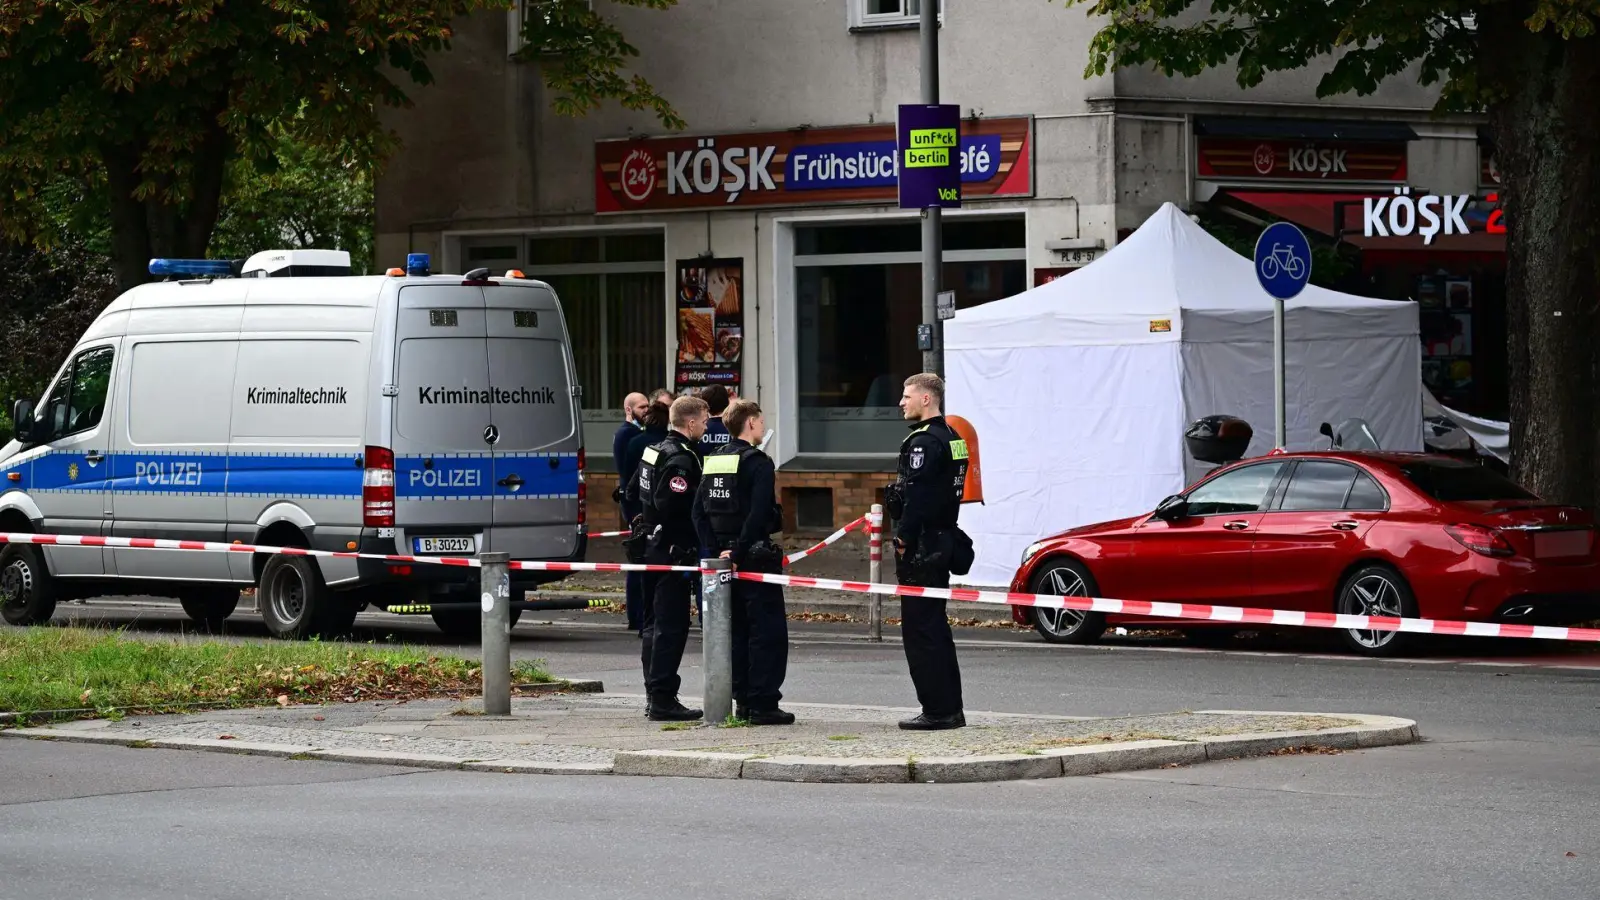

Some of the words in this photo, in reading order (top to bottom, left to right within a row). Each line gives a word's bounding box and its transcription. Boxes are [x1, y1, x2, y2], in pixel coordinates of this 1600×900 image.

[909, 151, 947, 164] berlin
[1288, 143, 1348, 178] KÖŞK
[628, 167, 648, 186] 24
[667, 138, 777, 203] KÖŞK
[960, 144, 990, 174] afé
[938, 188, 958, 200] Volt
[1363, 186, 1471, 246] KÖŞK
[1061, 251, 1070, 262] PL
[1072, 251, 1081, 262] 49
[1086, 251, 1096, 261] 57
[247, 386, 347, 405] Kriminaltechnik
[419, 386, 555, 405] Kriminaltechnik
[702, 433, 730, 444] OLIZEI
[135, 461, 202, 485] POLIZEI
[409, 469, 481, 487] POLIZEI
[713, 477, 724, 487] BE
[709, 489, 730, 498] 36216
[425, 539, 432, 551] B
[438, 539, 469, 551] 30219
